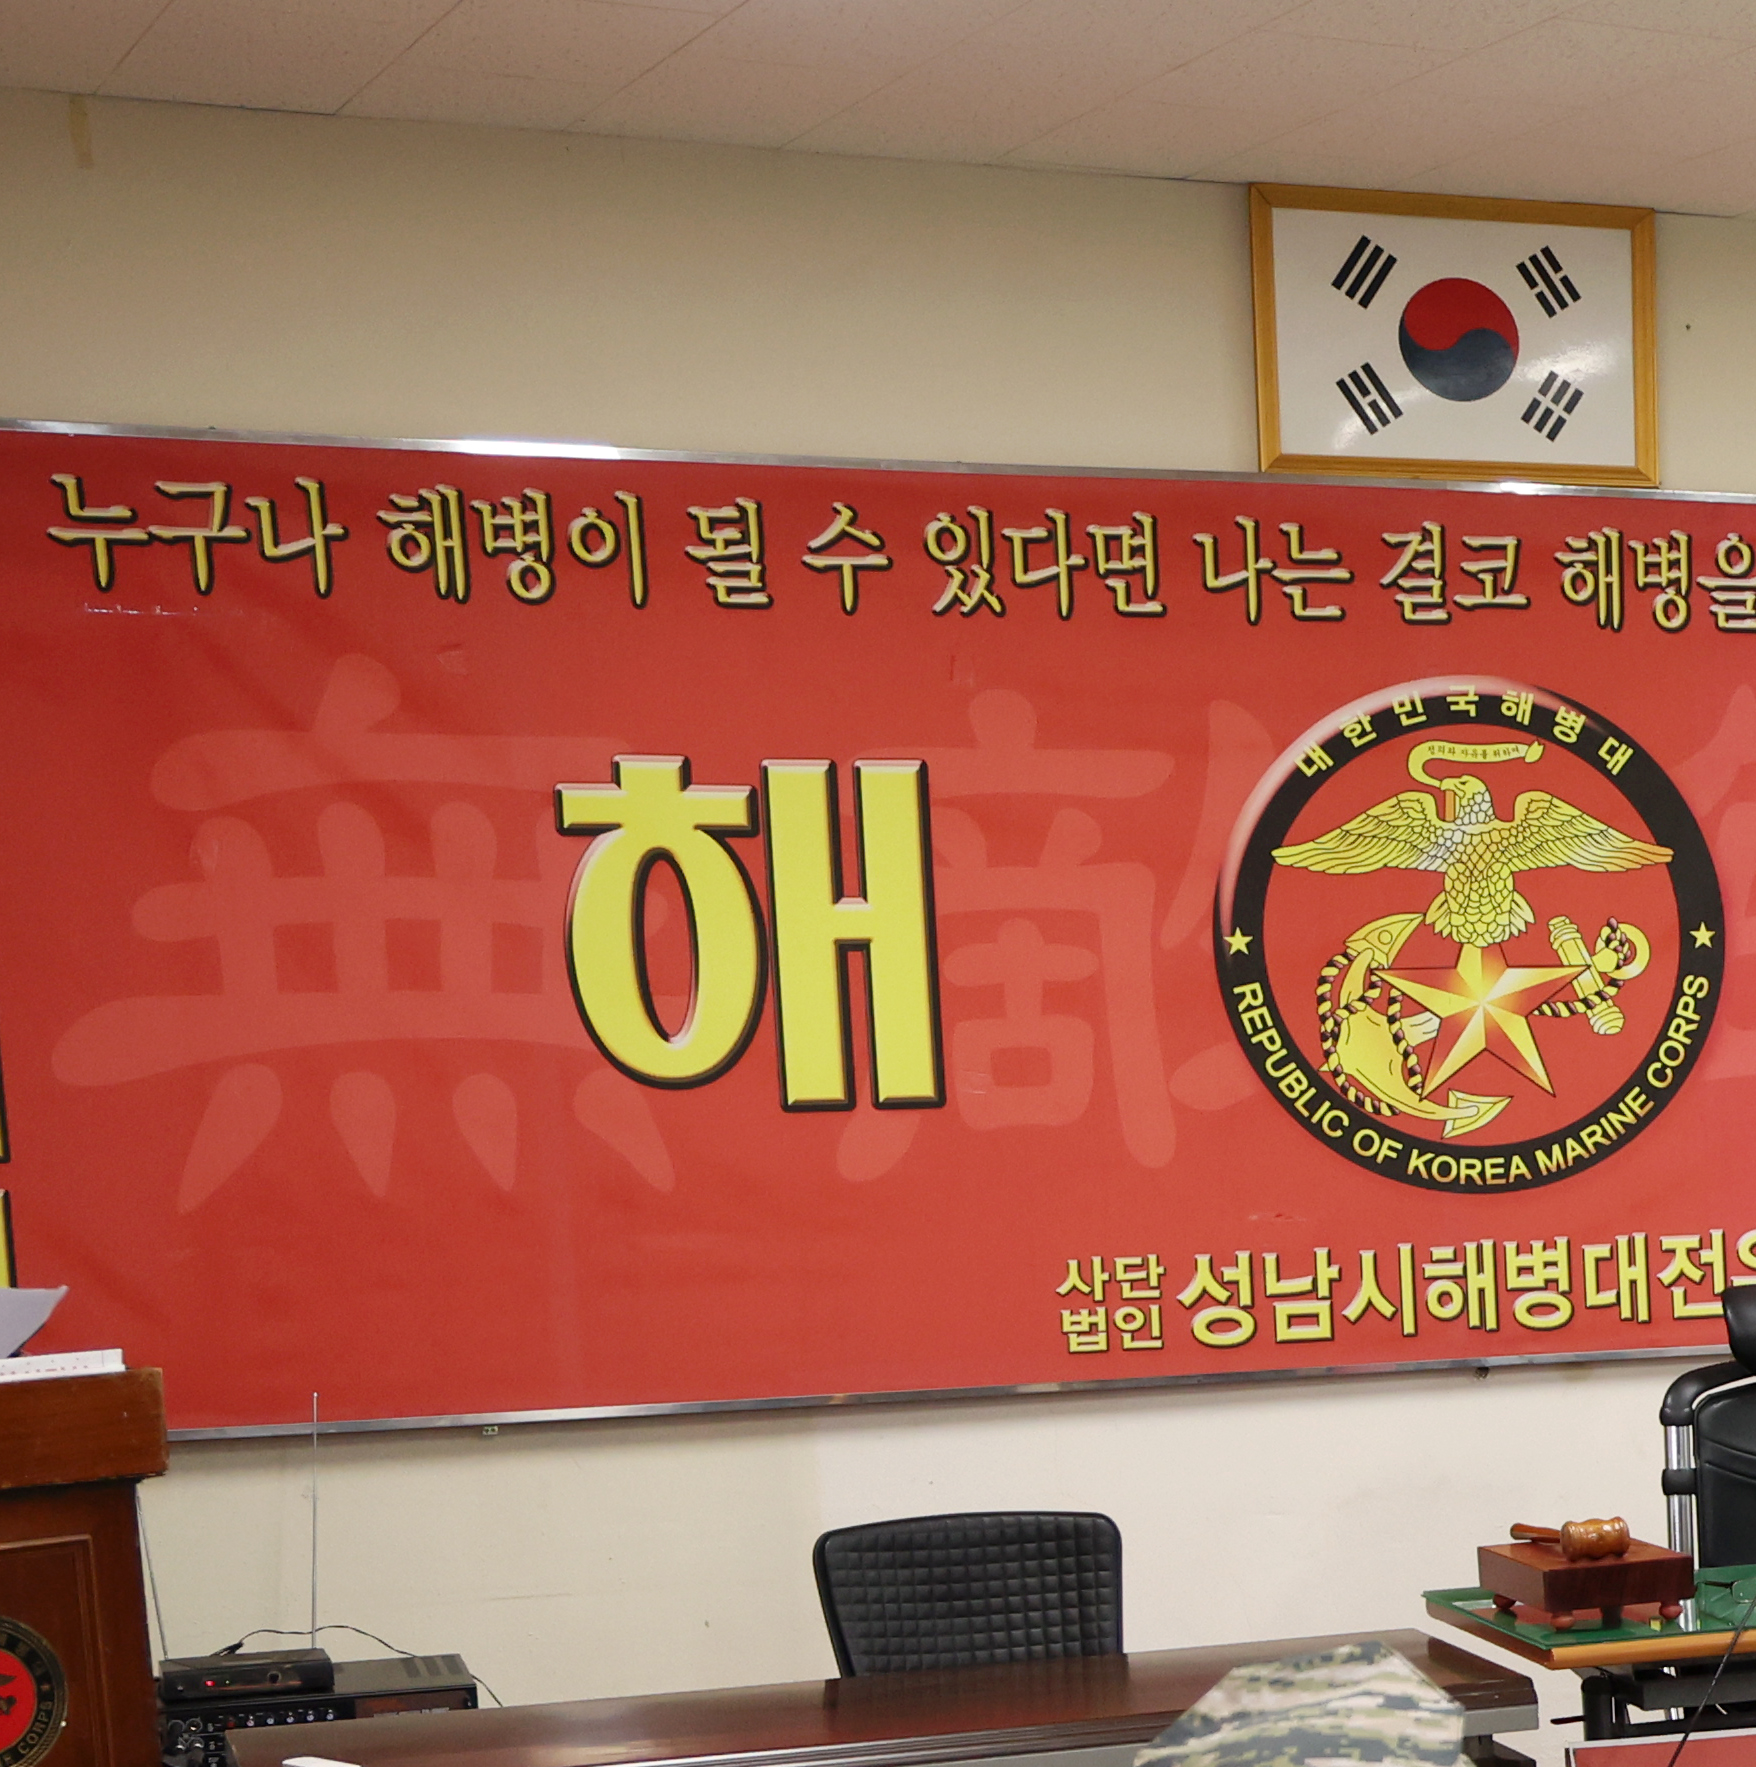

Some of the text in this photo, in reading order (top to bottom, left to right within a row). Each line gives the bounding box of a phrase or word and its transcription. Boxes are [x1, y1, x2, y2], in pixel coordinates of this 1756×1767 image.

[46, 472, 347, 598] 누구나
[377, 483, 648, 609] 해병이
[685, 495, 775, 612] 될
[802, 501, 894, 615] 수
[923, 504, 1168, 620] 있다면
[1193, 514, 1356, 626] 나는
[1380, 520, 1533, 626] 결코
[1293, 683, 1634, 778] 대한민국해병대
[555, 754, 938, 1112] 해
[1232, 974, 1710, 1185] REPUBLIC OF KOREA MARINE CORPS
[1054, 1252, 1166, 1302] 사단
[1059, 1303, 1165, 1354] 법인
